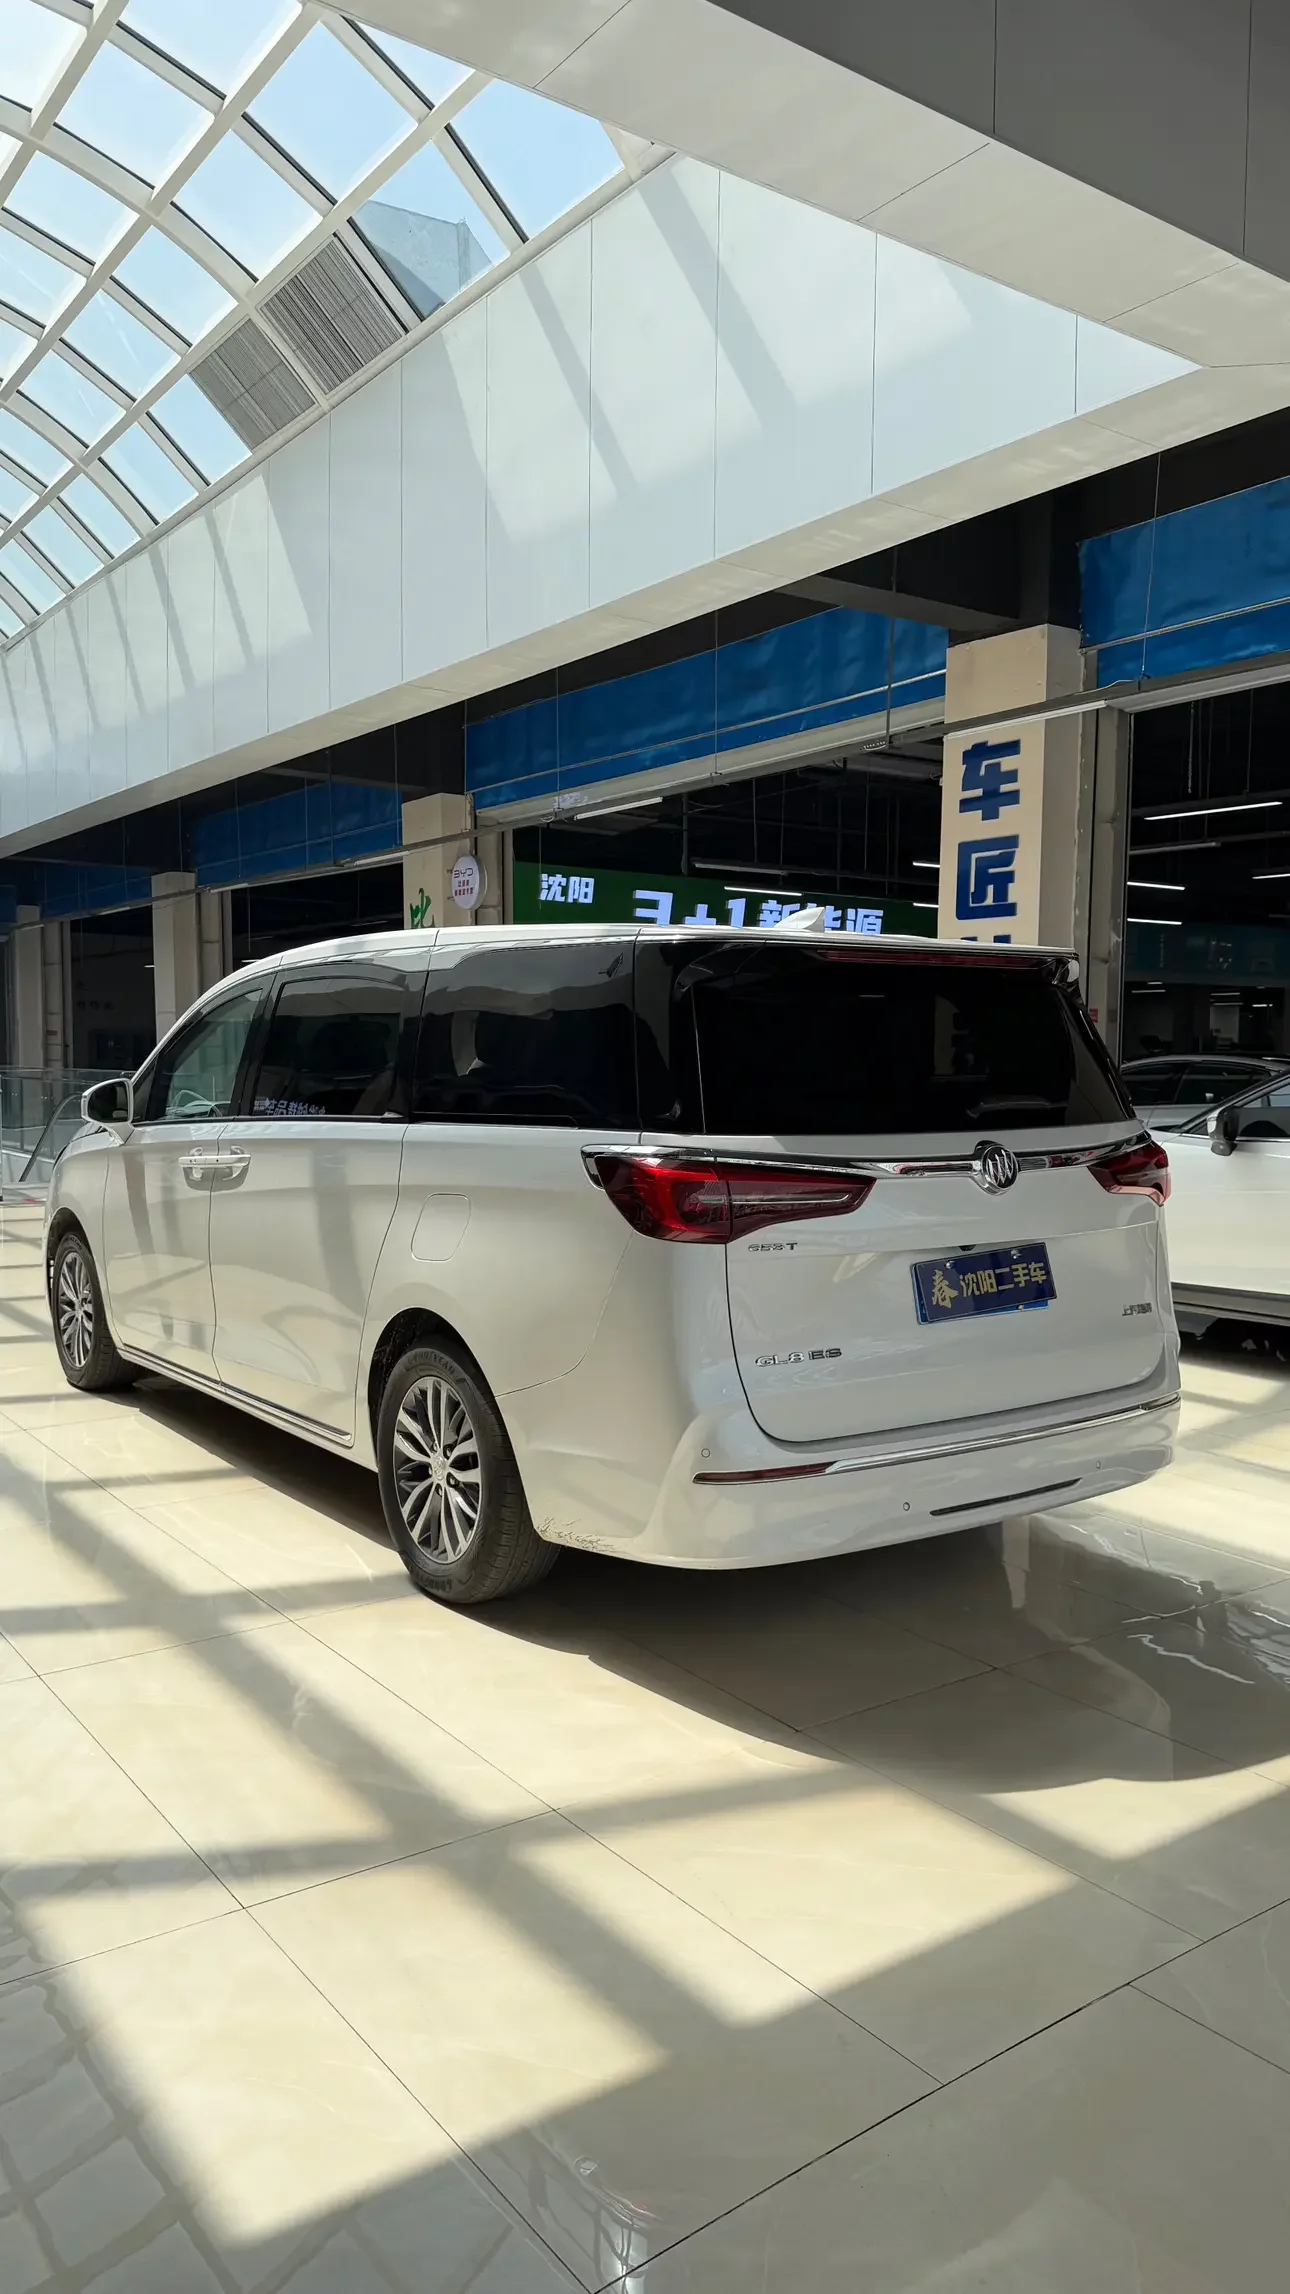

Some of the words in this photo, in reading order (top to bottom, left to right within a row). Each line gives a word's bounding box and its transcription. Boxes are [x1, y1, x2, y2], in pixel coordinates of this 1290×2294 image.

[956, 739, 1021, 944] 车匠
[540, 873, 594, 904] 沈阳
[959, 1262, 1047, 1298] 沈阳二手车
[755, 1351, 805, 1368] GL8
[808, 1347, 843, 1361] ES
